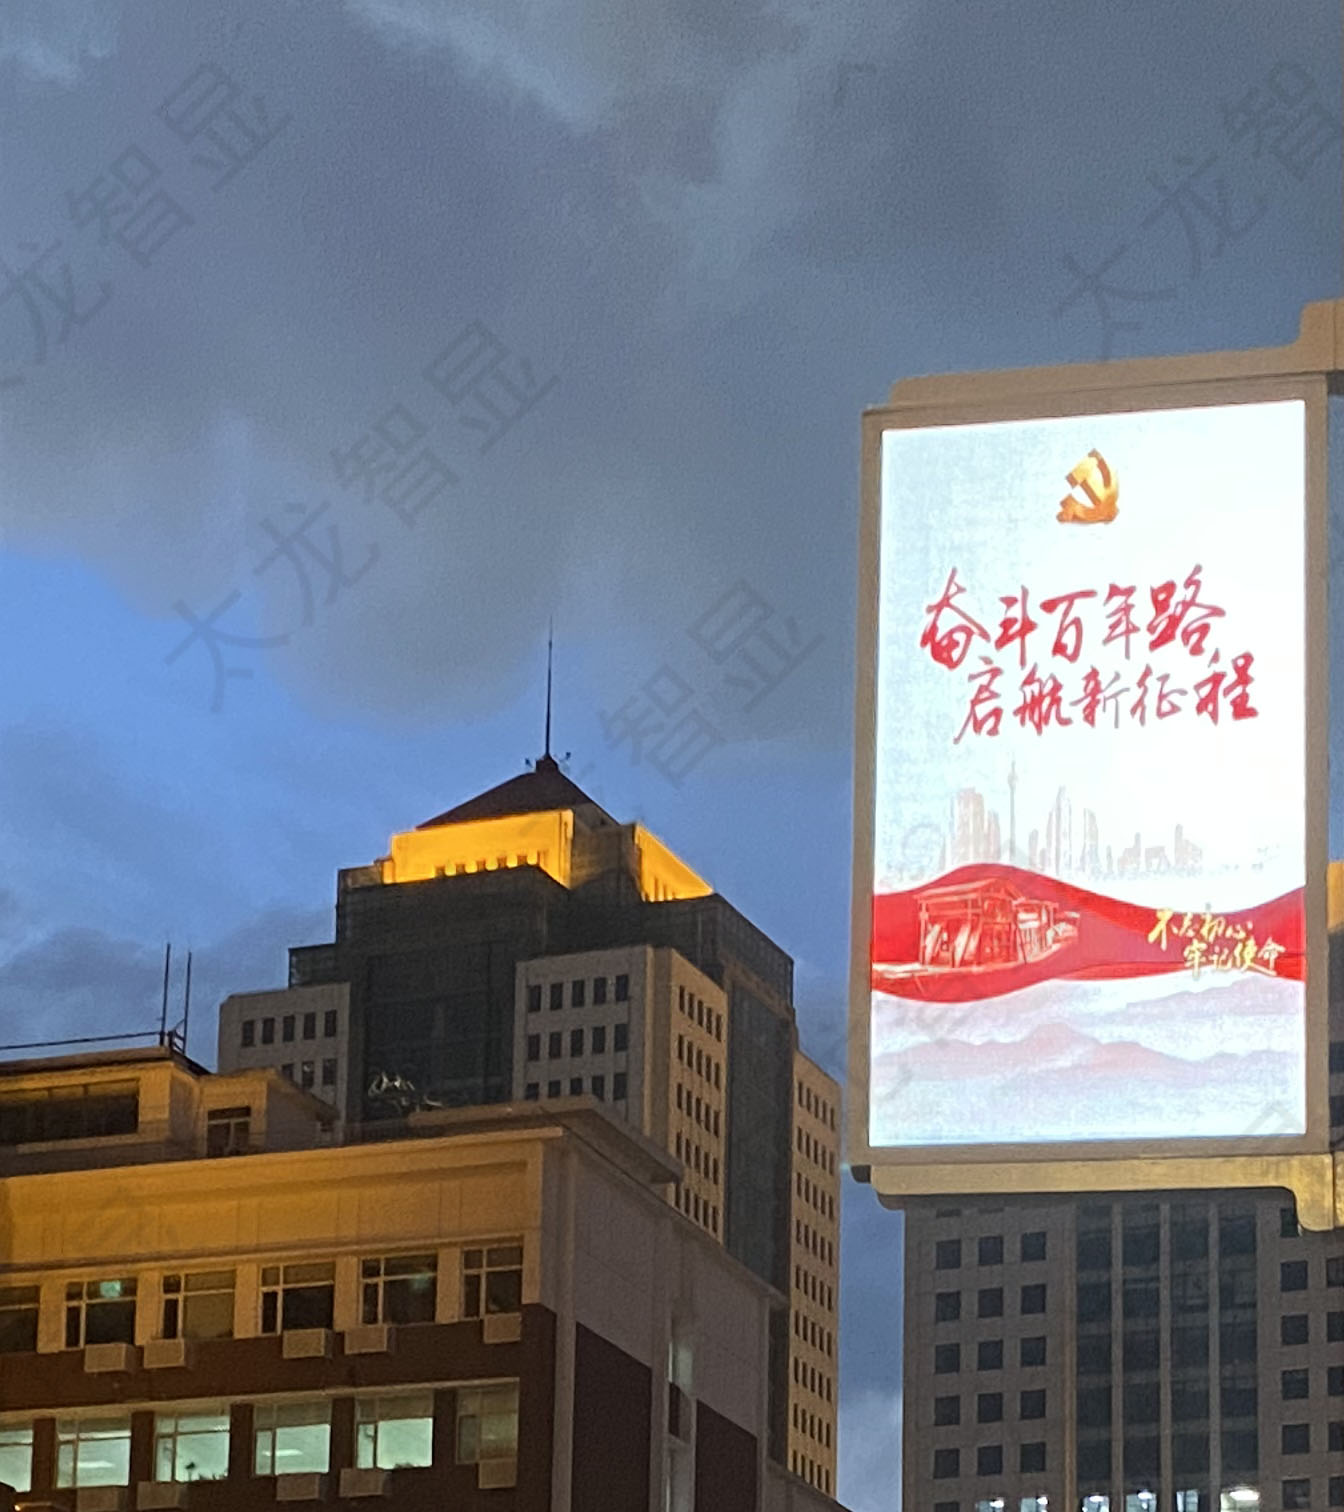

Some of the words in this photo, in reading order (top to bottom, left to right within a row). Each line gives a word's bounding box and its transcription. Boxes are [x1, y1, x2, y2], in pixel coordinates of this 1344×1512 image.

[920, 564, 1227, 671] 奋斗百年路
[953, 648, 1259, 745] 启航新征程
[1147, 903, 1254, 951] 不忘初心
[1182, 936, 1287, 980] 牢记使命
